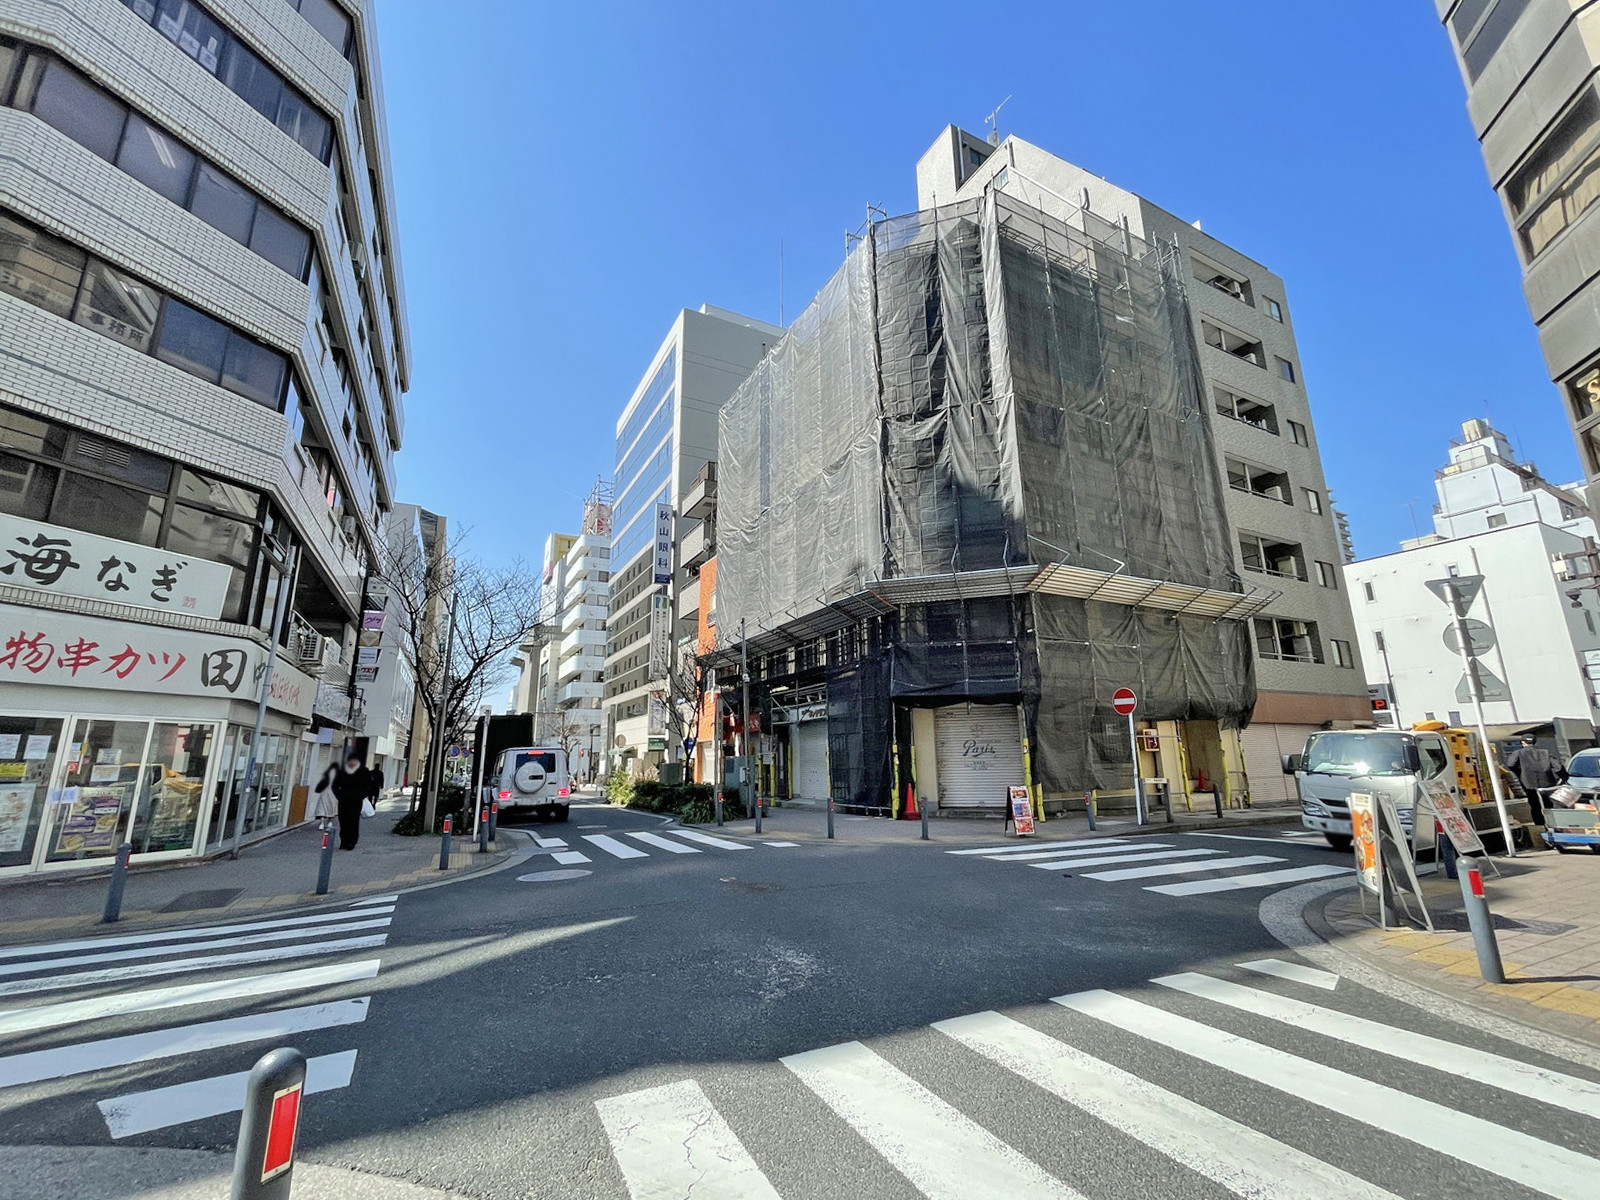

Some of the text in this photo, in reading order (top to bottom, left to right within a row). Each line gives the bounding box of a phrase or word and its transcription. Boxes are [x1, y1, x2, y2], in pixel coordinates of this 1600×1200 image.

[0, 533, 188, 602] 海なぎ
[657, 510, 669, 568] 秋山眼科
[1375, 698, 1385, 710] P
